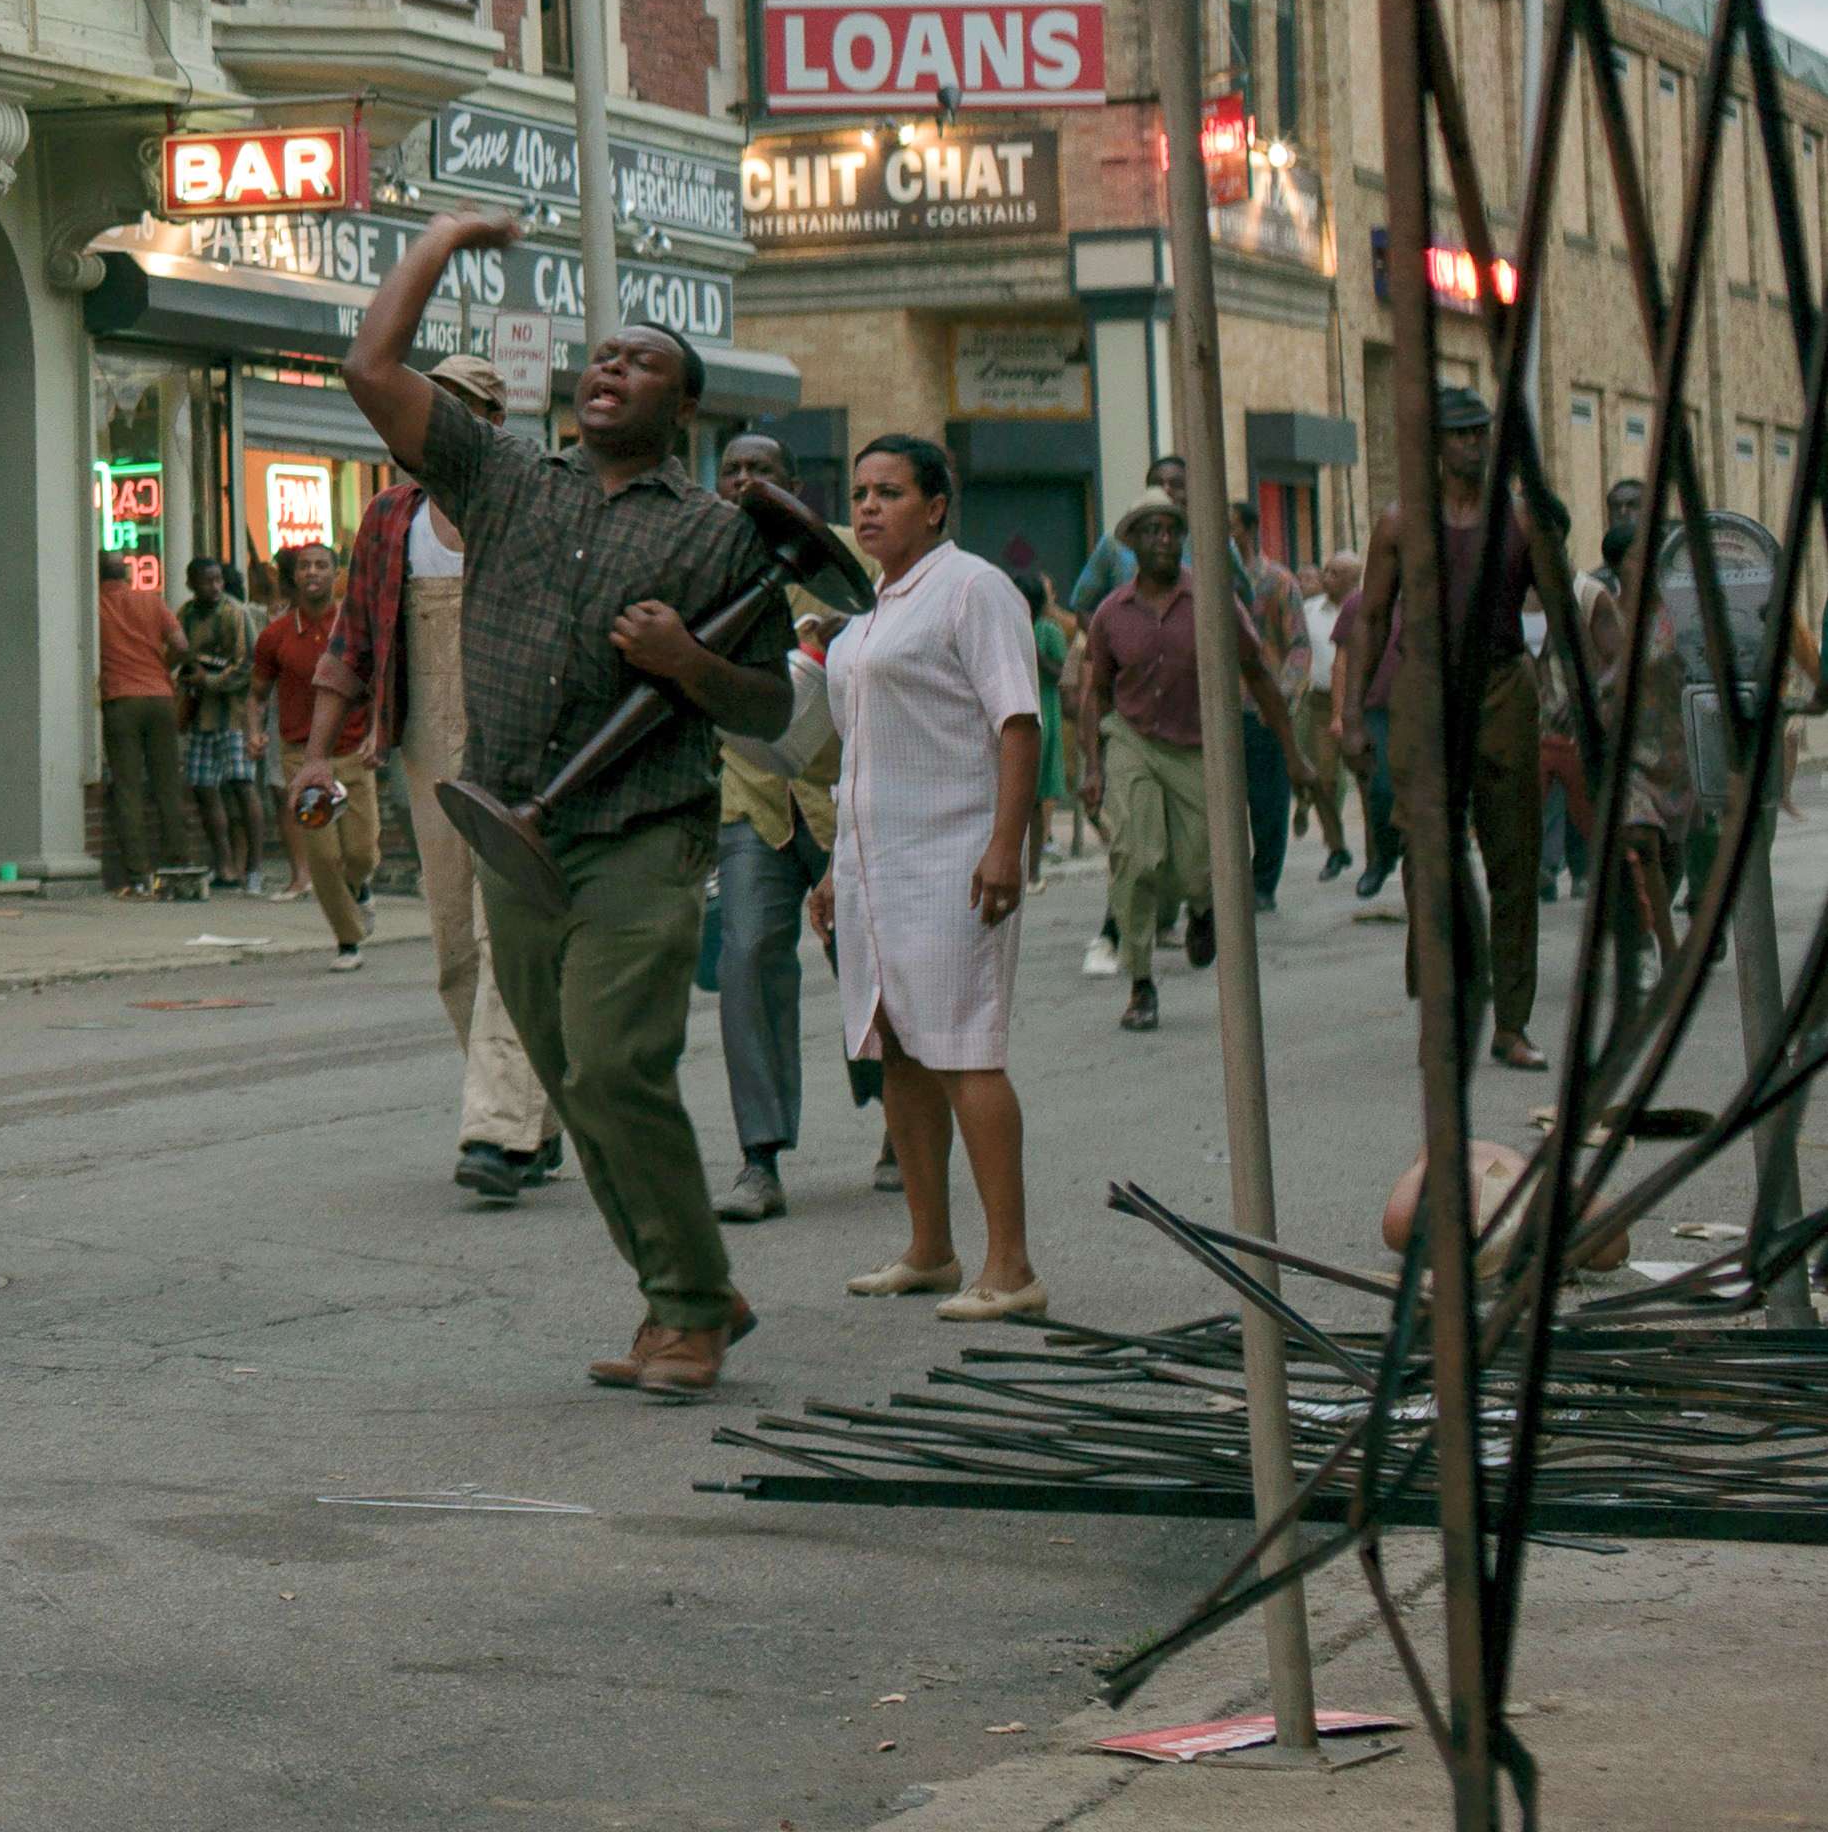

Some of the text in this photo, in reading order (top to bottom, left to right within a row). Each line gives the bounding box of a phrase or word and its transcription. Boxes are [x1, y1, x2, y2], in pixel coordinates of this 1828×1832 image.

[783, 9, 1083, 92] LOANS
[173, 137, 335, 203] BAR
[445, 111, 510, 174] Save
[620, 166, 736, 233] MERCHANDISE
[741, 140, 1035, 213] CHIT CHAT
[925, 201, 1037, 229] COCKTAILS
[190, 212, 382, 286] PARADISE
[396, 231, 506, 305] ANS
[646, 272, 724, 337] GOLD
[426, 320, 462, 354] MOST
[512, 323, 533, 343] NO
